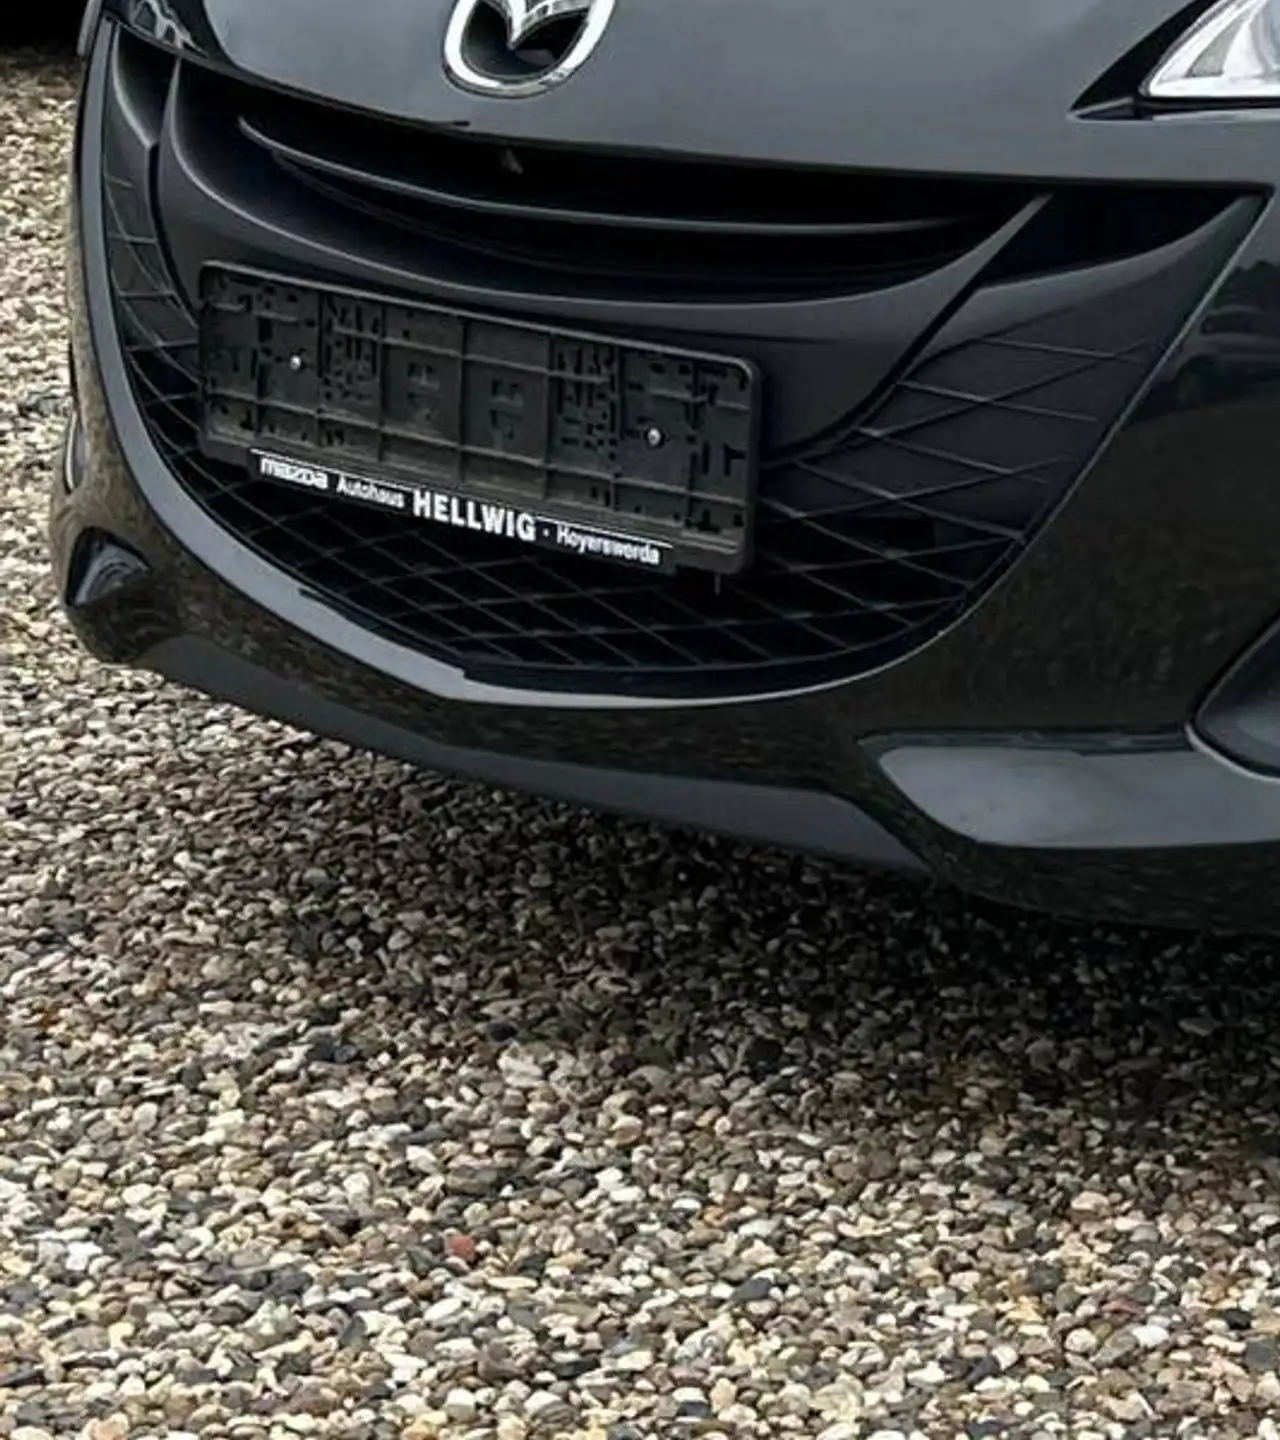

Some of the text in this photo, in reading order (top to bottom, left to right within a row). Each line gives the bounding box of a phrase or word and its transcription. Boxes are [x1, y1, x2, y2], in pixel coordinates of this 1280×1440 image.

[261, 458, 660, 565] mazda Autohaus HELLWIG Hoyerswerda
